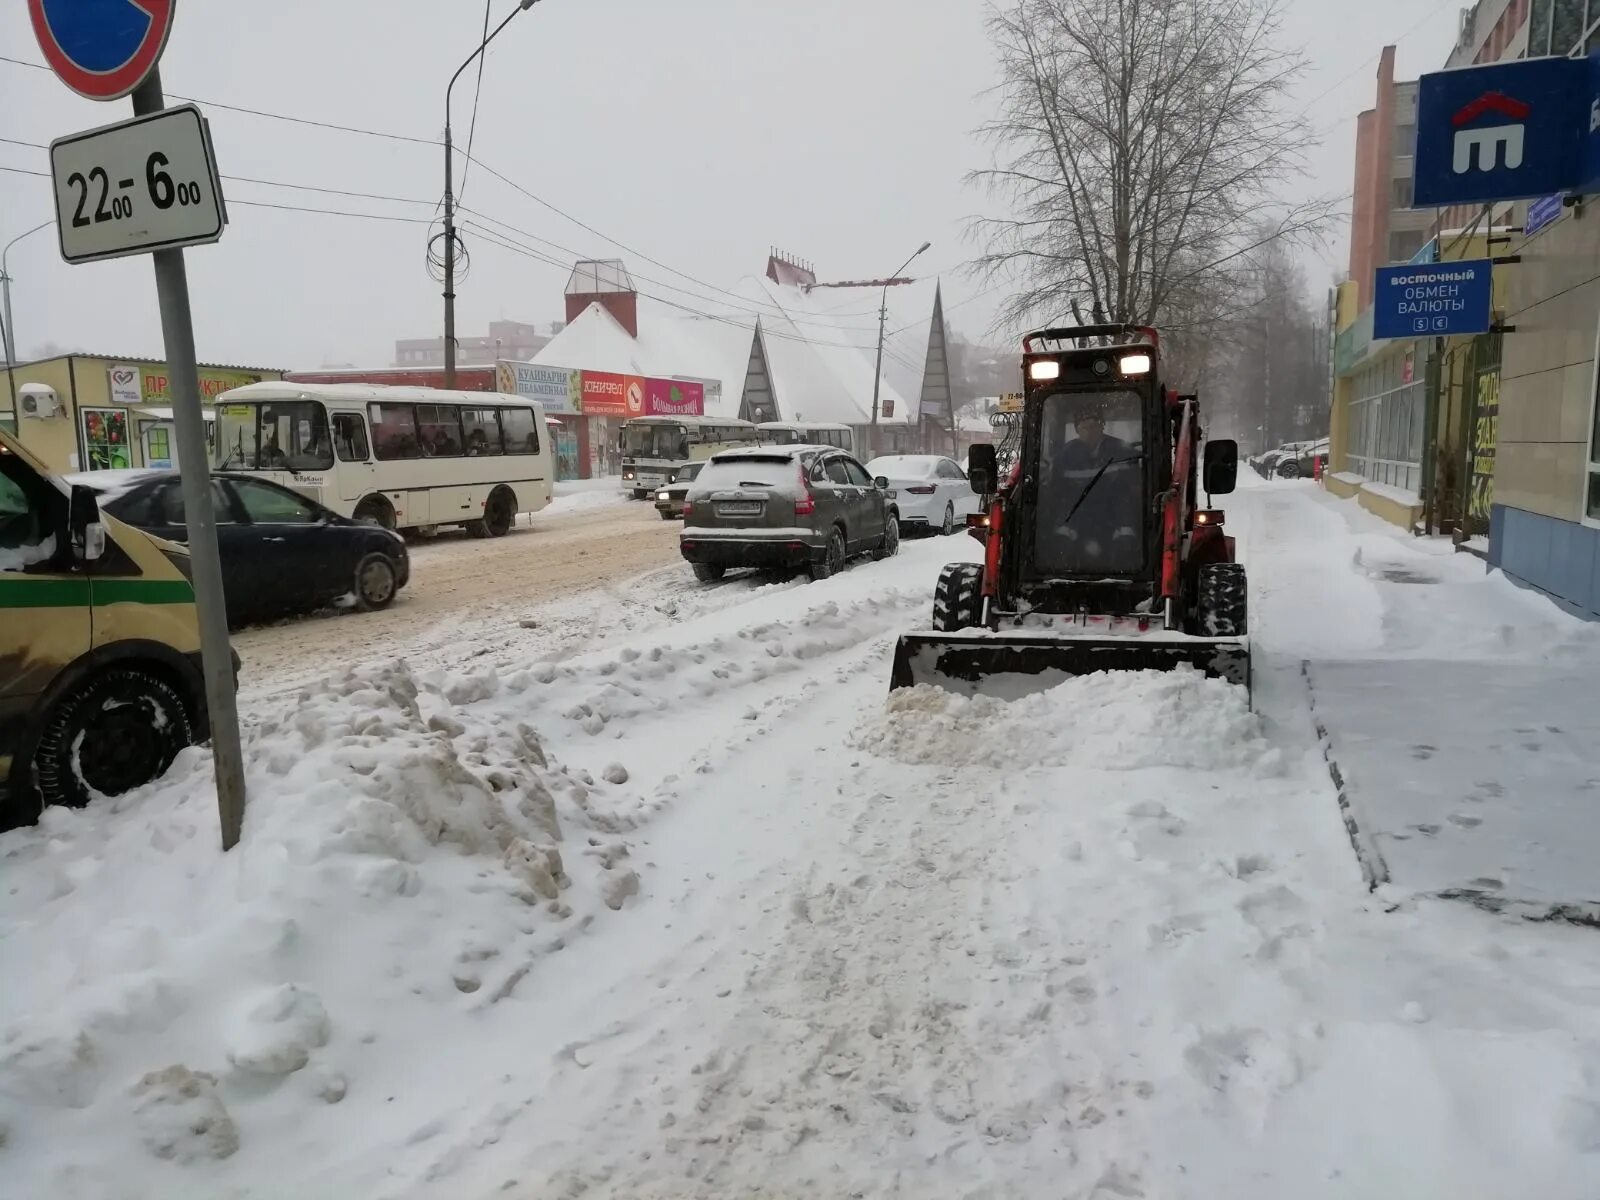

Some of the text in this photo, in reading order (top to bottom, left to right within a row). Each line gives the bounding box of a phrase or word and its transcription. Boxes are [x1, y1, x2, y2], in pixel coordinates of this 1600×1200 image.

[1405, 284, 1459, 300] ОБМЕН
[1397, 299, 1465, 314] ВАЛЮТЫ
[518, 367, 567, 383] КУЛИНАРИЯ
[518, 382, 568, 396] ПЕЛЬМЕННАЯ
